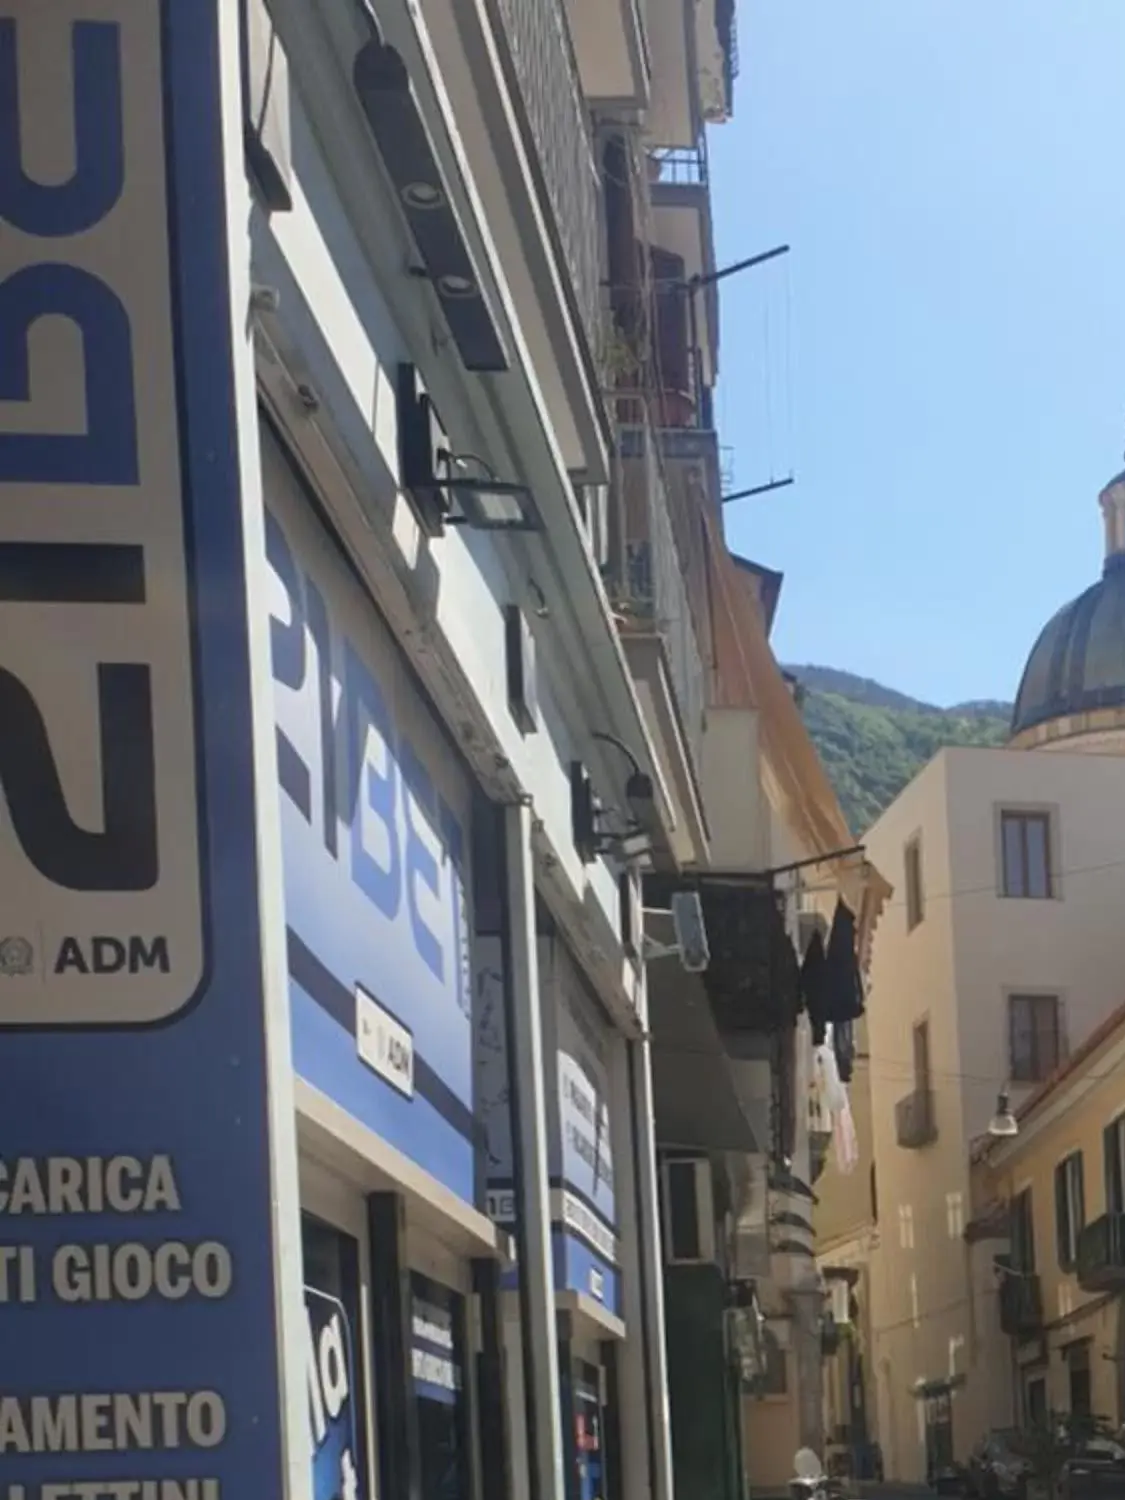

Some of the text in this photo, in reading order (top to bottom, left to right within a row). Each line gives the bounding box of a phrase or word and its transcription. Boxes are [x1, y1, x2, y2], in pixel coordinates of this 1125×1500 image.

[54, 936, 171, 975] ADM
[0, 1155, 181, 1214] ARICA
[53, 1241, 232, 1302] GIOCO
[0, 1391, 227, 1453] AMENTO
